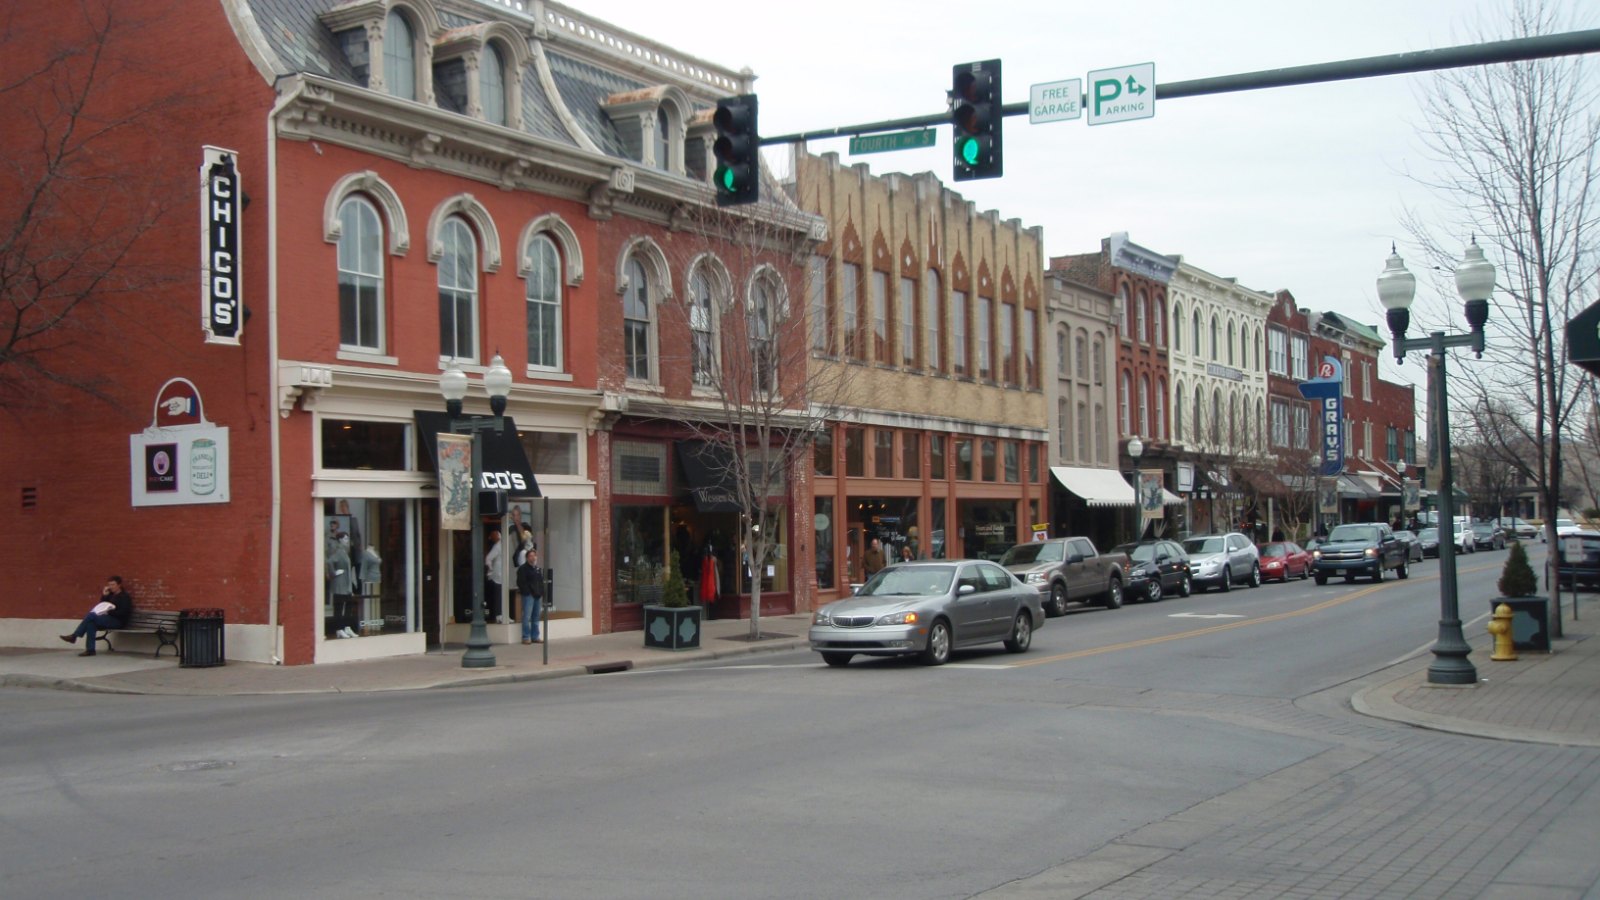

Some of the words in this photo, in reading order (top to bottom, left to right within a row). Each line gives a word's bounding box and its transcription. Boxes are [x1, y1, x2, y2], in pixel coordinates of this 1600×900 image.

[1042, 87, 1069, 100] FREE
[1034, 102, 1077, 117] GARAGE
[853, 135, 897, 152] FOURTH
[922, 131, 930, 144] S
[213, 175, 236, 325] CHICO'S
[1325, 398, 1339, 461] GRAY'S
